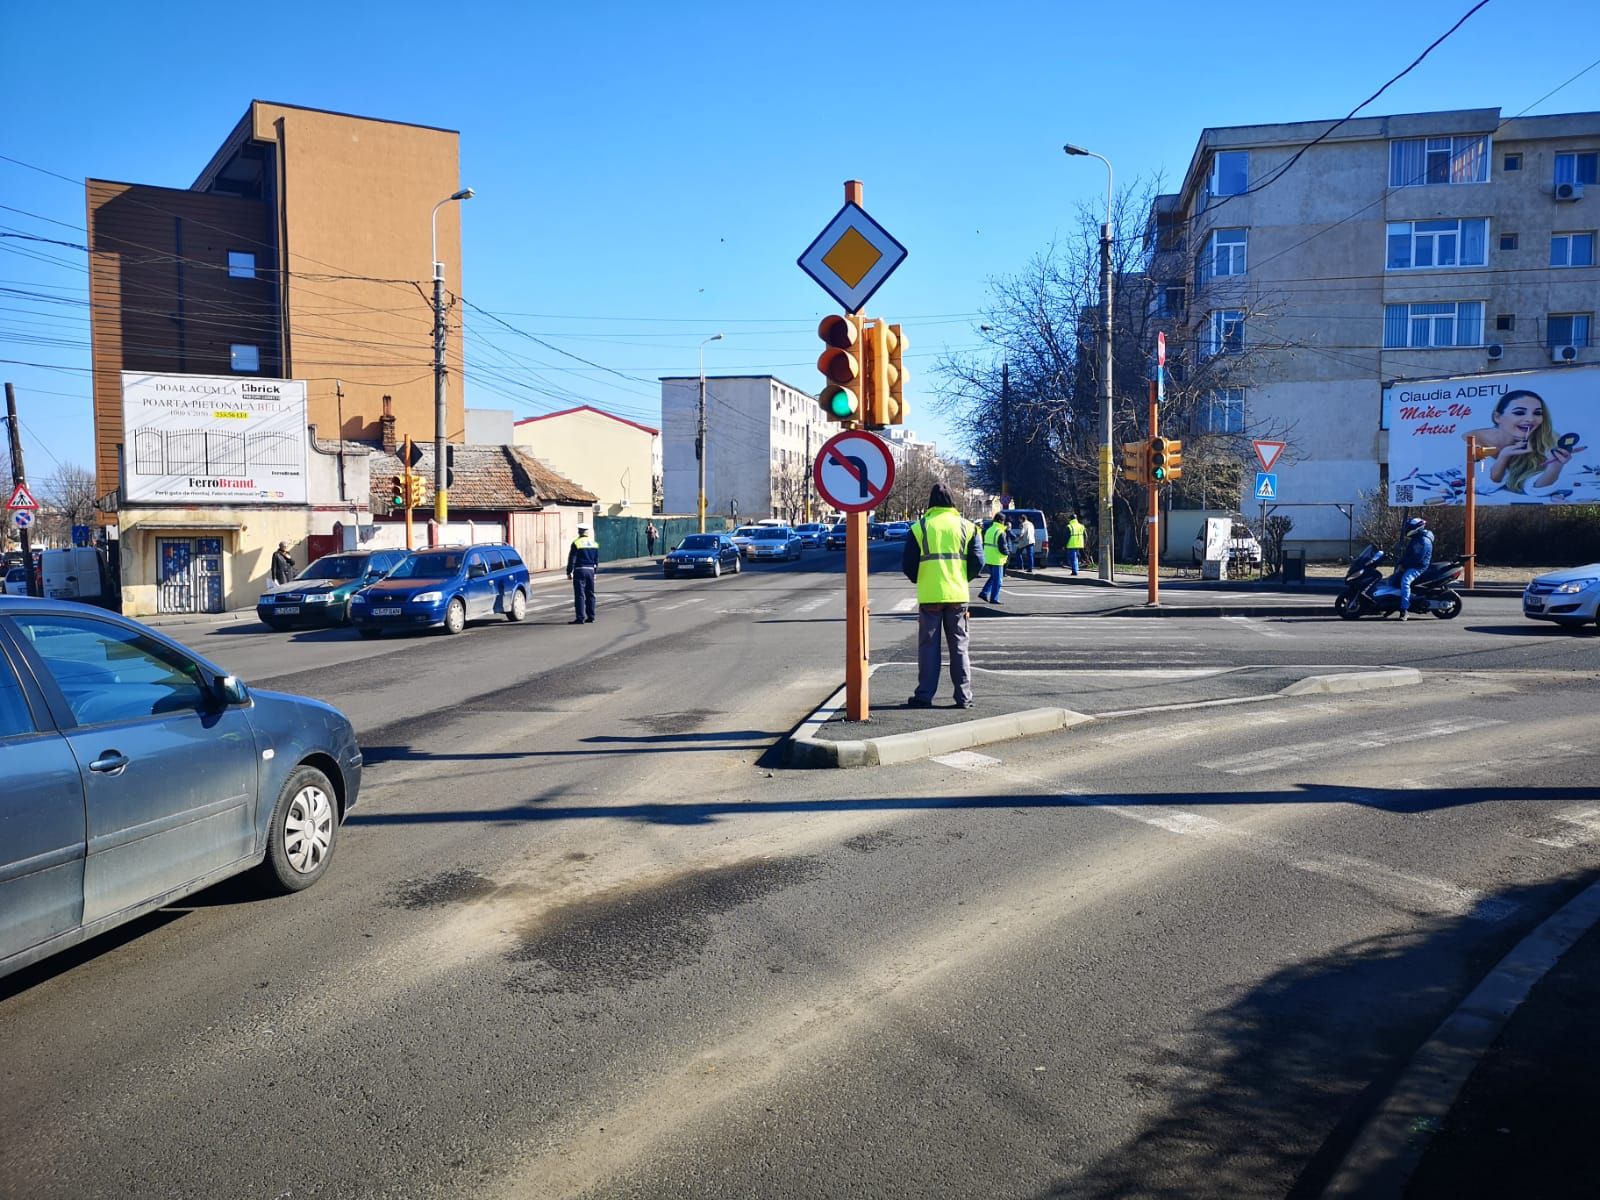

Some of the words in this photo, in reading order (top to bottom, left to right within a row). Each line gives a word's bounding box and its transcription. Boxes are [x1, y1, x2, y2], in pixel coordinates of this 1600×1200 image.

[155, 383, 186, 393] DOAR
[188, 384, 221, 394] ACUM
[223, 386, 237, 395] LA
[1399, 388, 1451, 403] Claudia
[1455, 383, 1509, 399] ADETU
[142, 398, 189, 409] POARTA
[257, 402, 292, 413] BELLA
[1399, 403, 1472, 420] Make-Up
[1412, 422, 1456, 436] Artist
